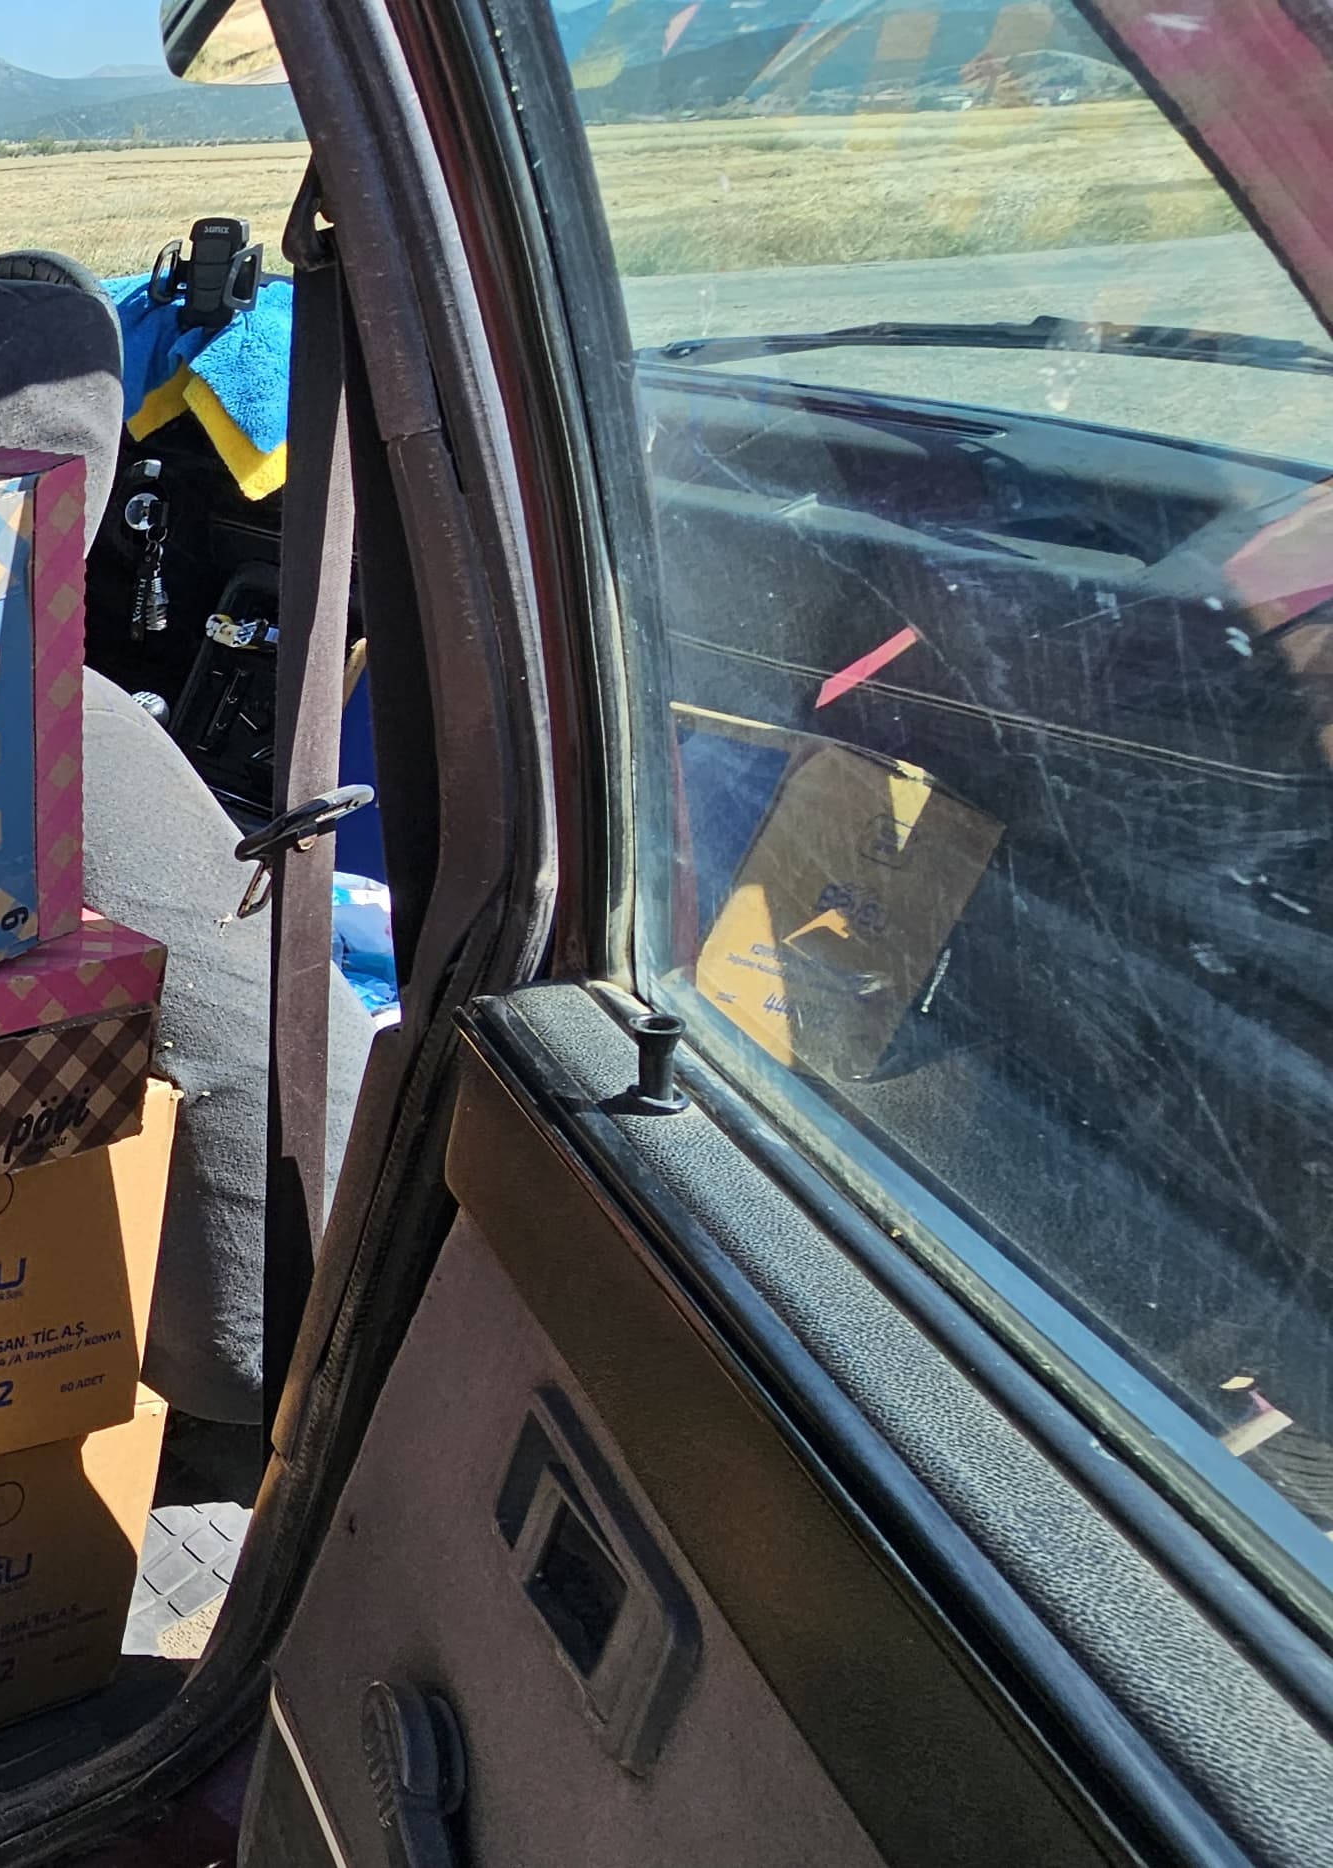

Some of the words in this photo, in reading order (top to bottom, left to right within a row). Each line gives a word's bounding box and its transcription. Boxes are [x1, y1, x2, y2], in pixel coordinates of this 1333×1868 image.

[0, 906, 29, 931] 6
[3, 1086, 91, 1164] pöti
[33, 1327, 59, 1345] TİC.
[62, 1321, 88, 1341] A.Ş.
[84, 1329, 122, 1348] KONYA
